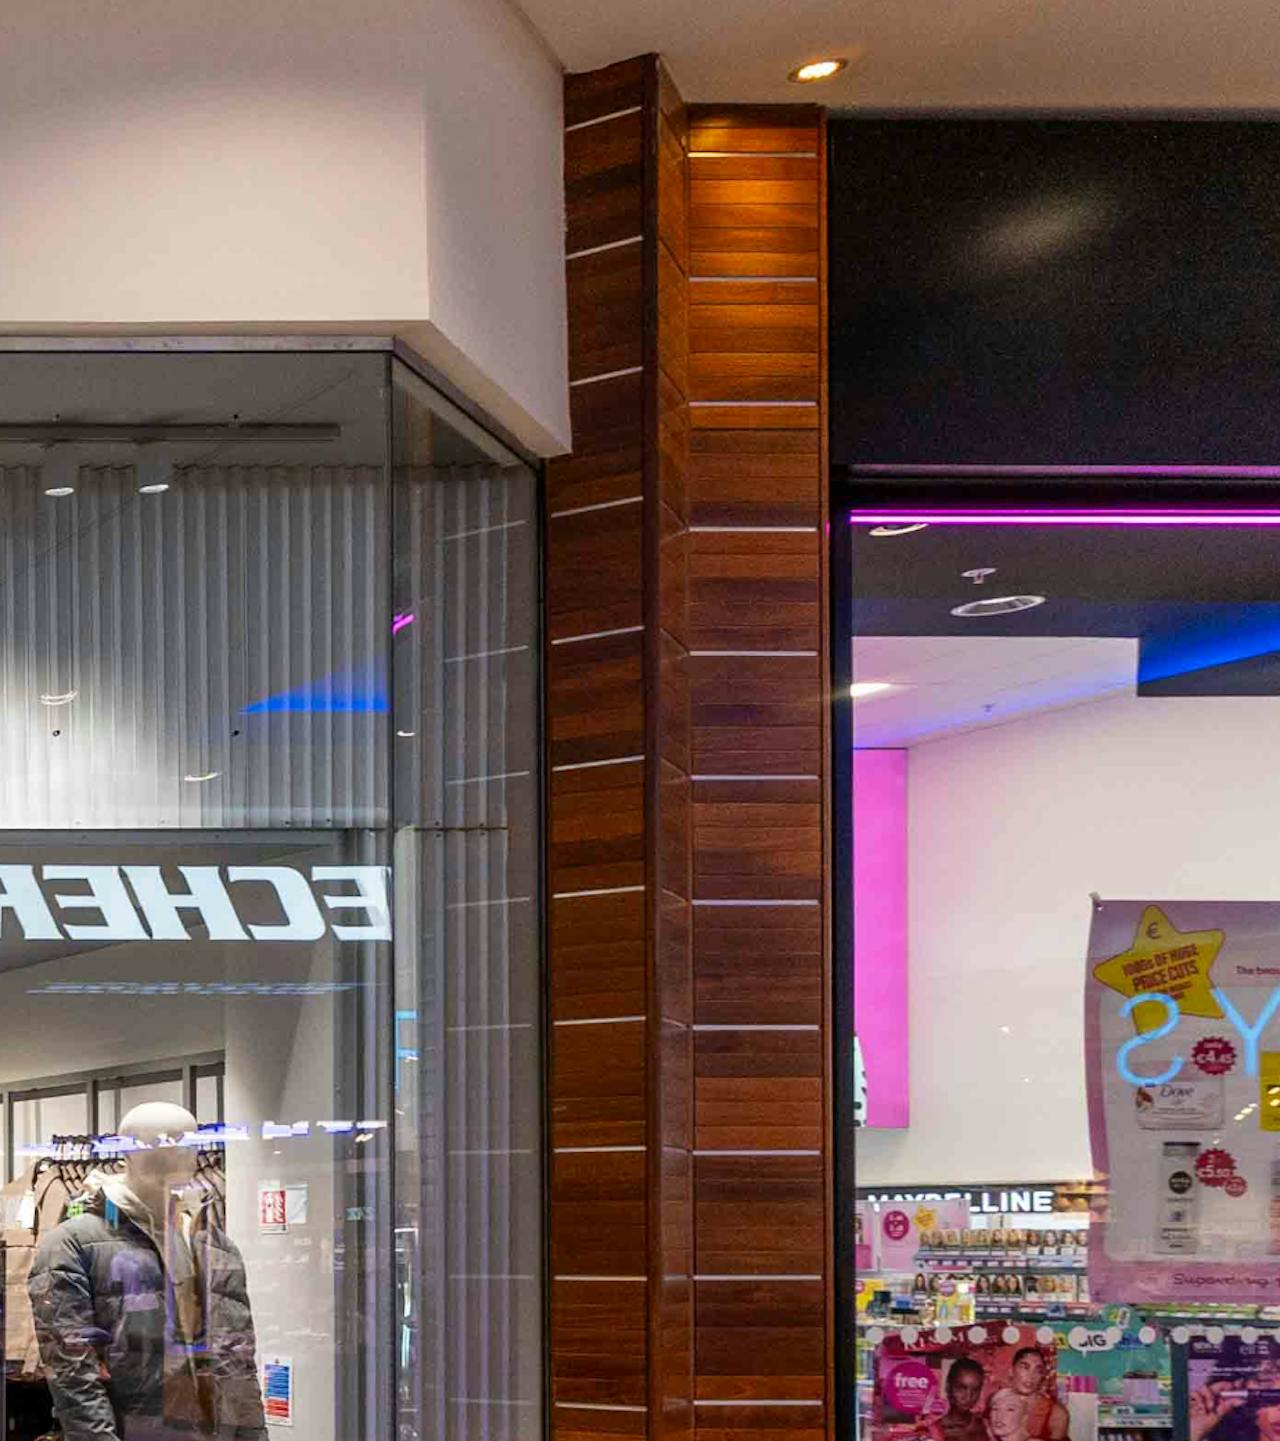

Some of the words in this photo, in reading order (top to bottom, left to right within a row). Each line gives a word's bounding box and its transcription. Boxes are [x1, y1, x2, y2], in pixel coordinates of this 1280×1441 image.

[867, 1191, 1055, 1213] LLINE
[1079, 1334, 1107, 1348] IG
[895, 1372, 930, 1390] free
